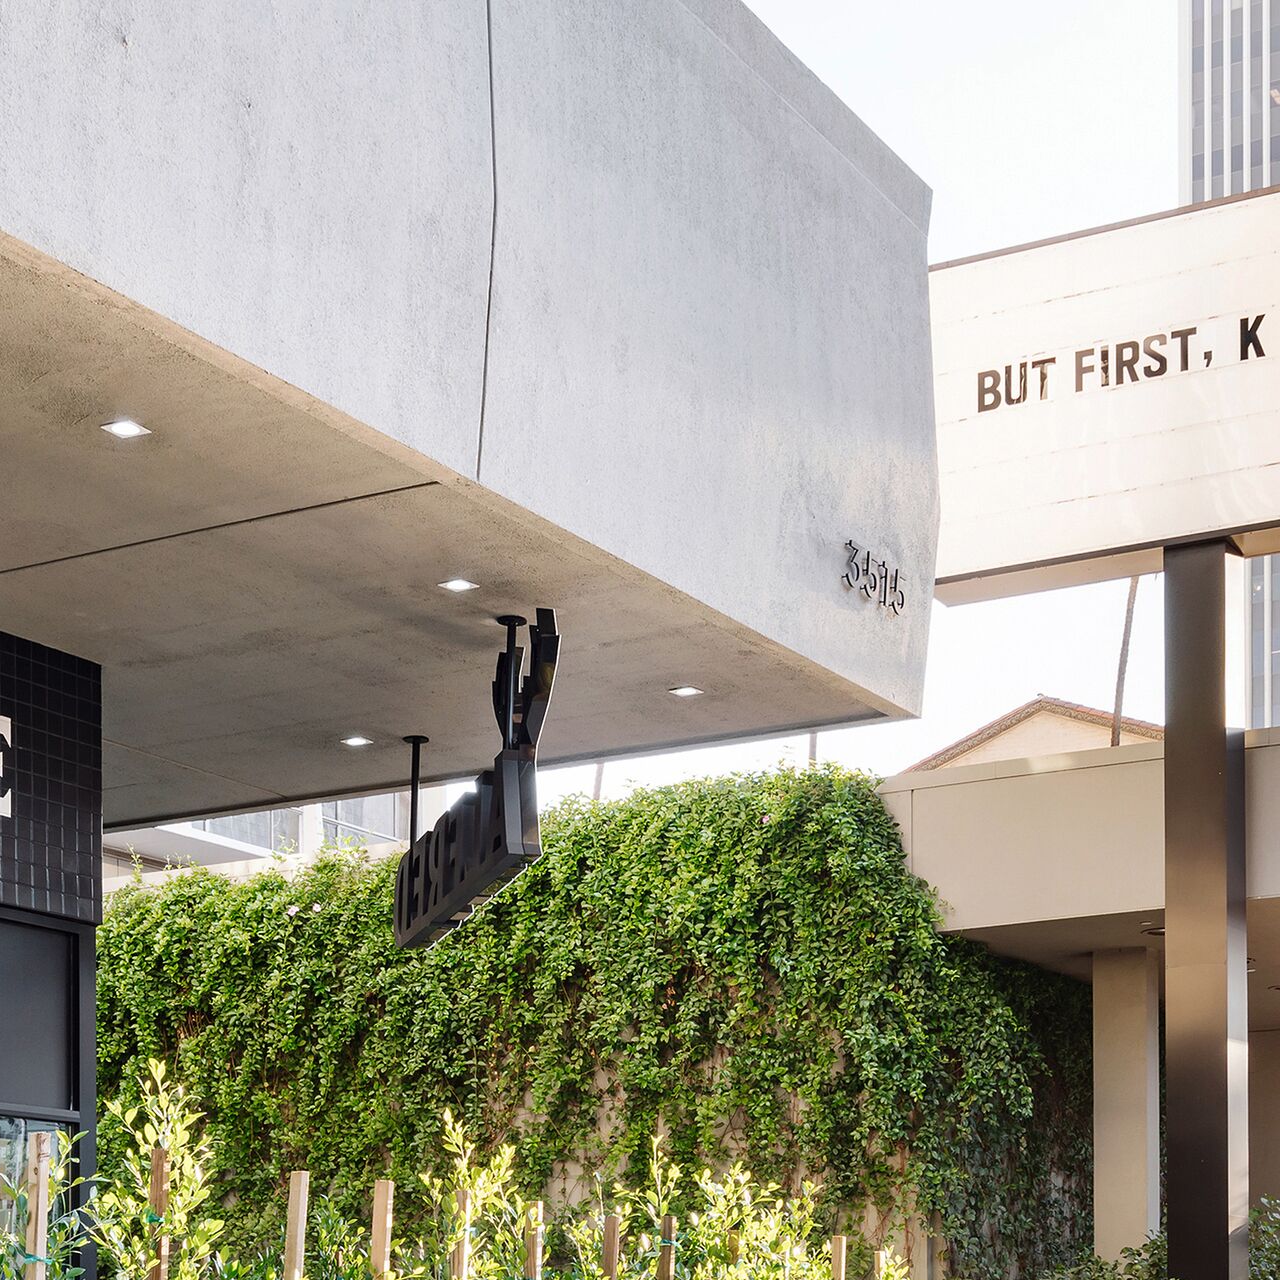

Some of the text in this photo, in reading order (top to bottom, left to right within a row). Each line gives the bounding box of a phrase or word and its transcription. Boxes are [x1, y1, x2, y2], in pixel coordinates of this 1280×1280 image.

[977, 356, 1056, 413] BUT
[1074, 326, 1214, 394] FIRST,
[1239, 313, 1266, 362] K
[840, 539, 907, 616] 3515
